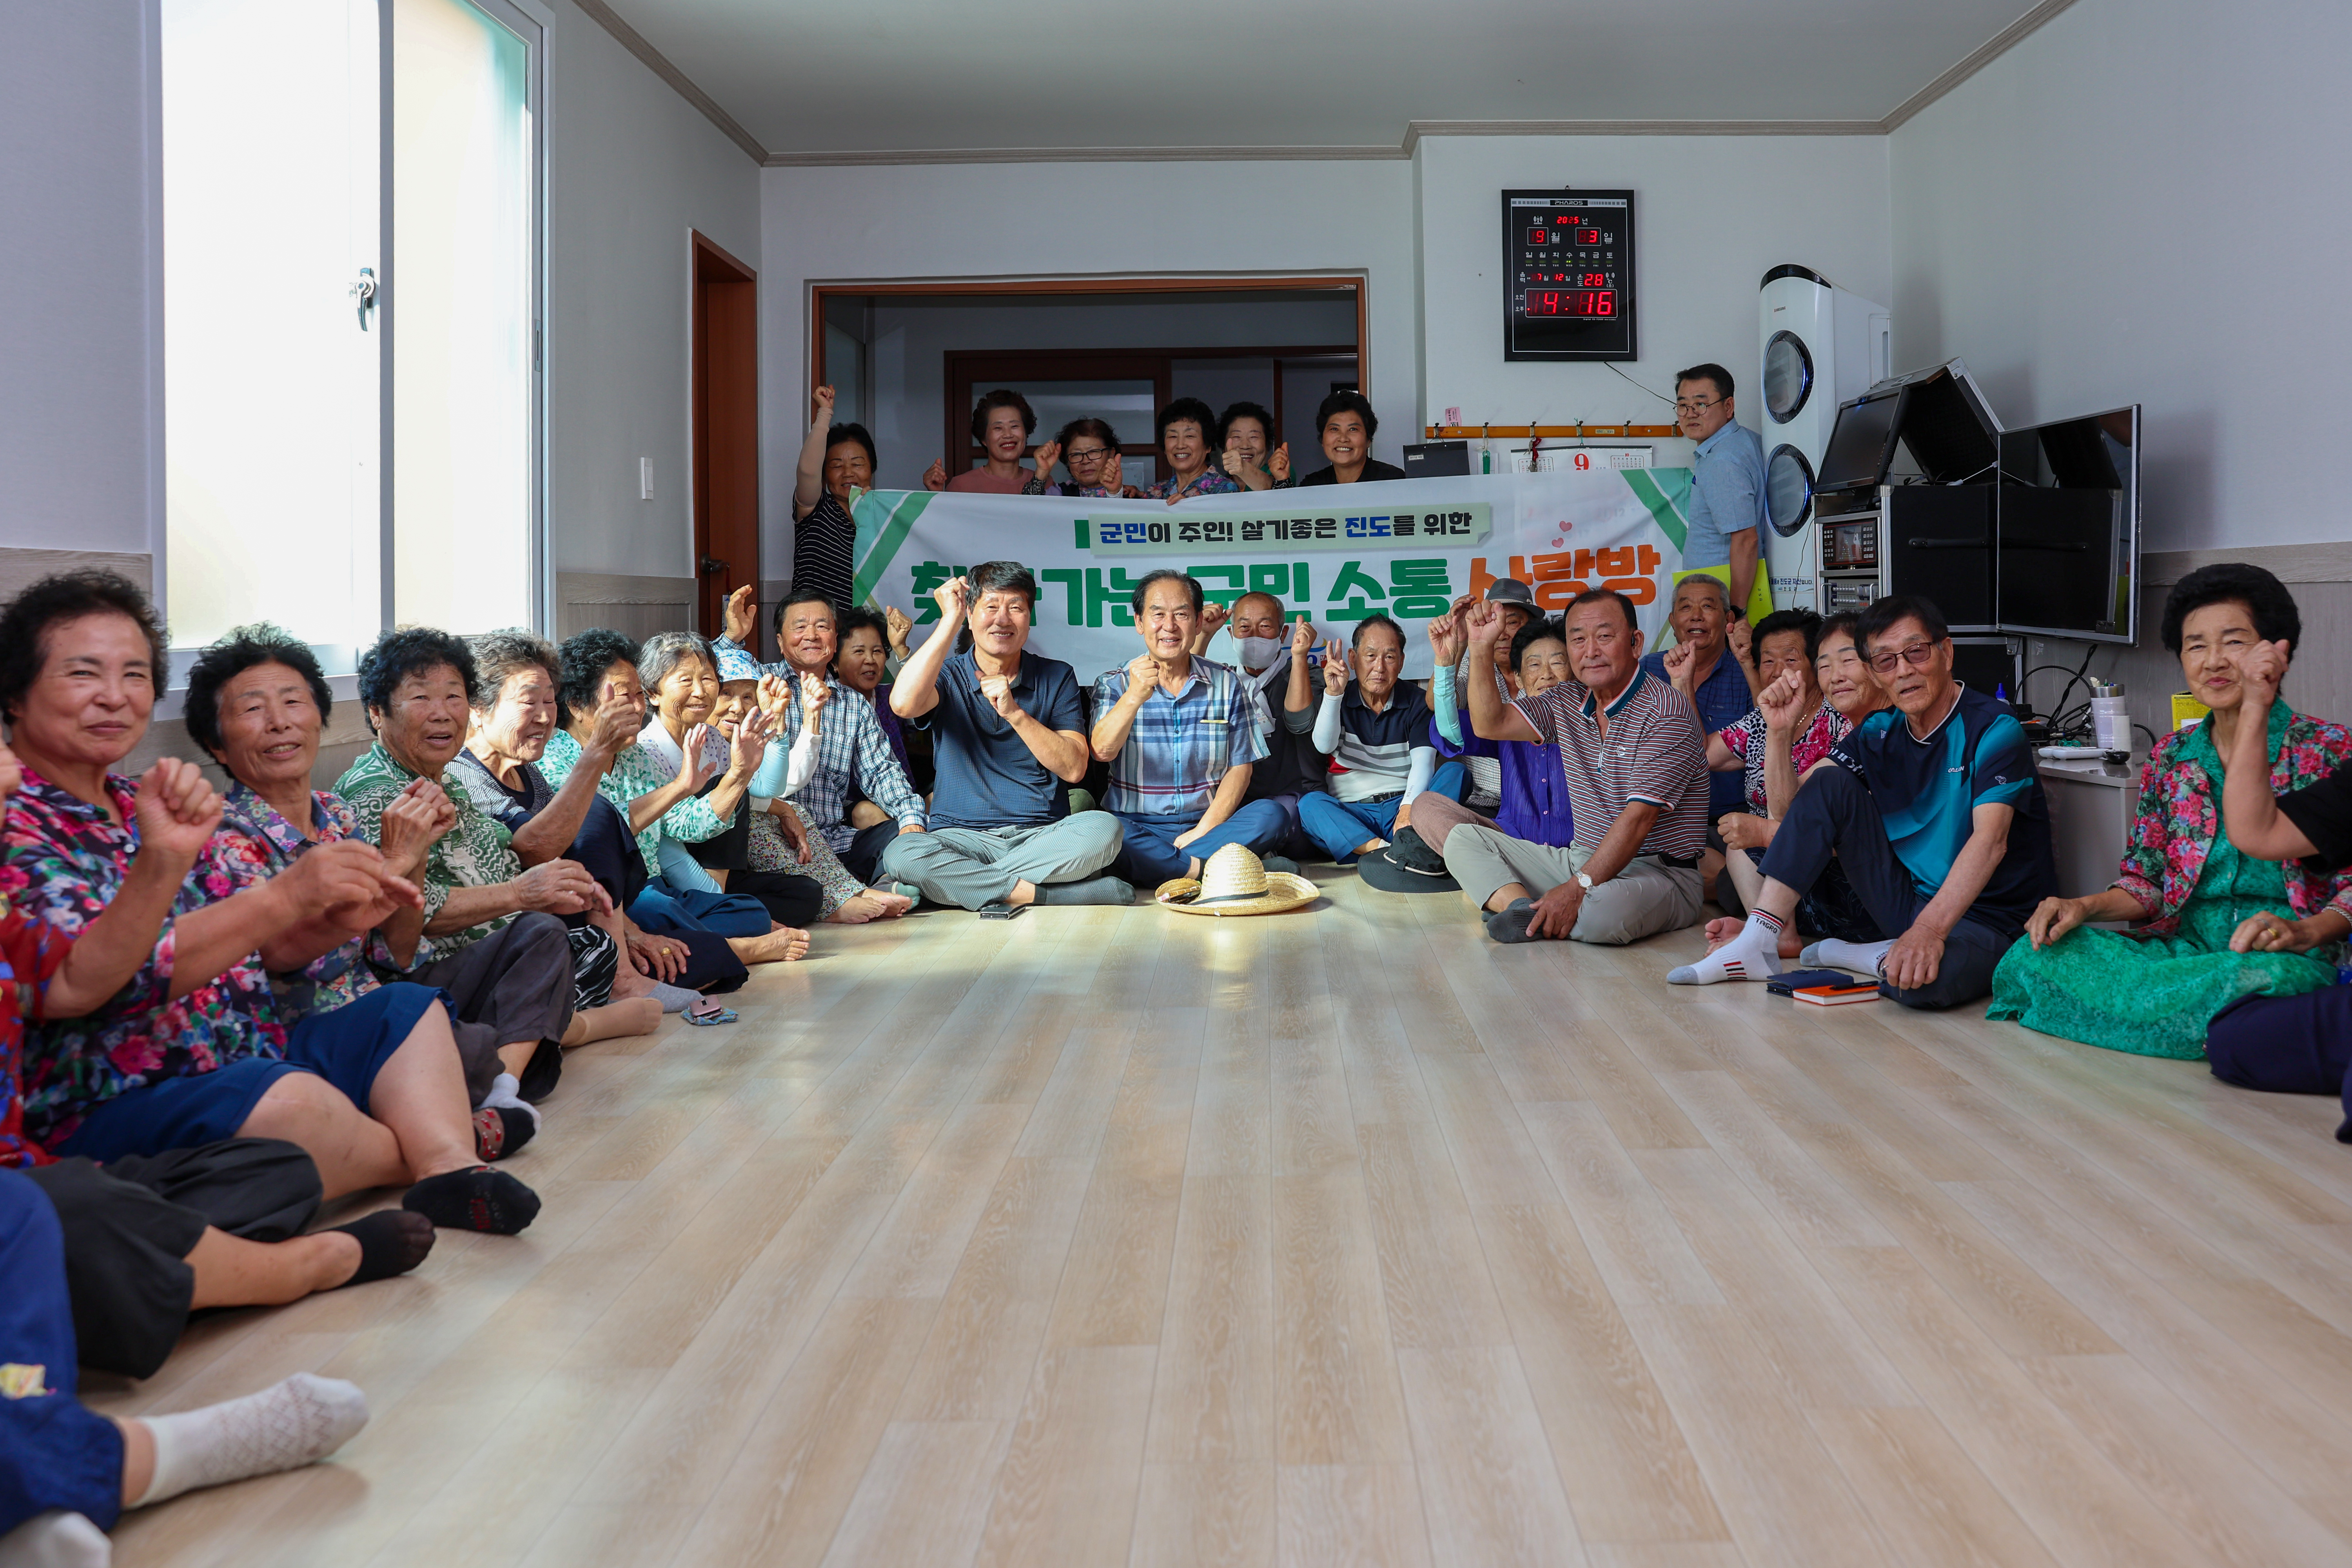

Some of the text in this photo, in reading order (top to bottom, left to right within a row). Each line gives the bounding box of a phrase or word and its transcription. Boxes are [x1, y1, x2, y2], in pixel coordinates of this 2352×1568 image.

[1536, 230, 1544, 243] 9
[1551, 232, 1560, 241] 월
[1589, 230, 1598, 243] 3
[1604, 232, 1612, 242] 일
[1577, 274, 1583, 286] 온도
[1584, 274, 1603, 286] 28
[1574, 453, 1589, 470] 9
[1100, 512, 1472, 544] 군민이 주인! 살기좋은 진도를 위한
[1326, 558, 1452, 621] 소통
[1469, 544, 1661, 610] 사랑방
[1756, 917, 1778, 933] TAGRO
